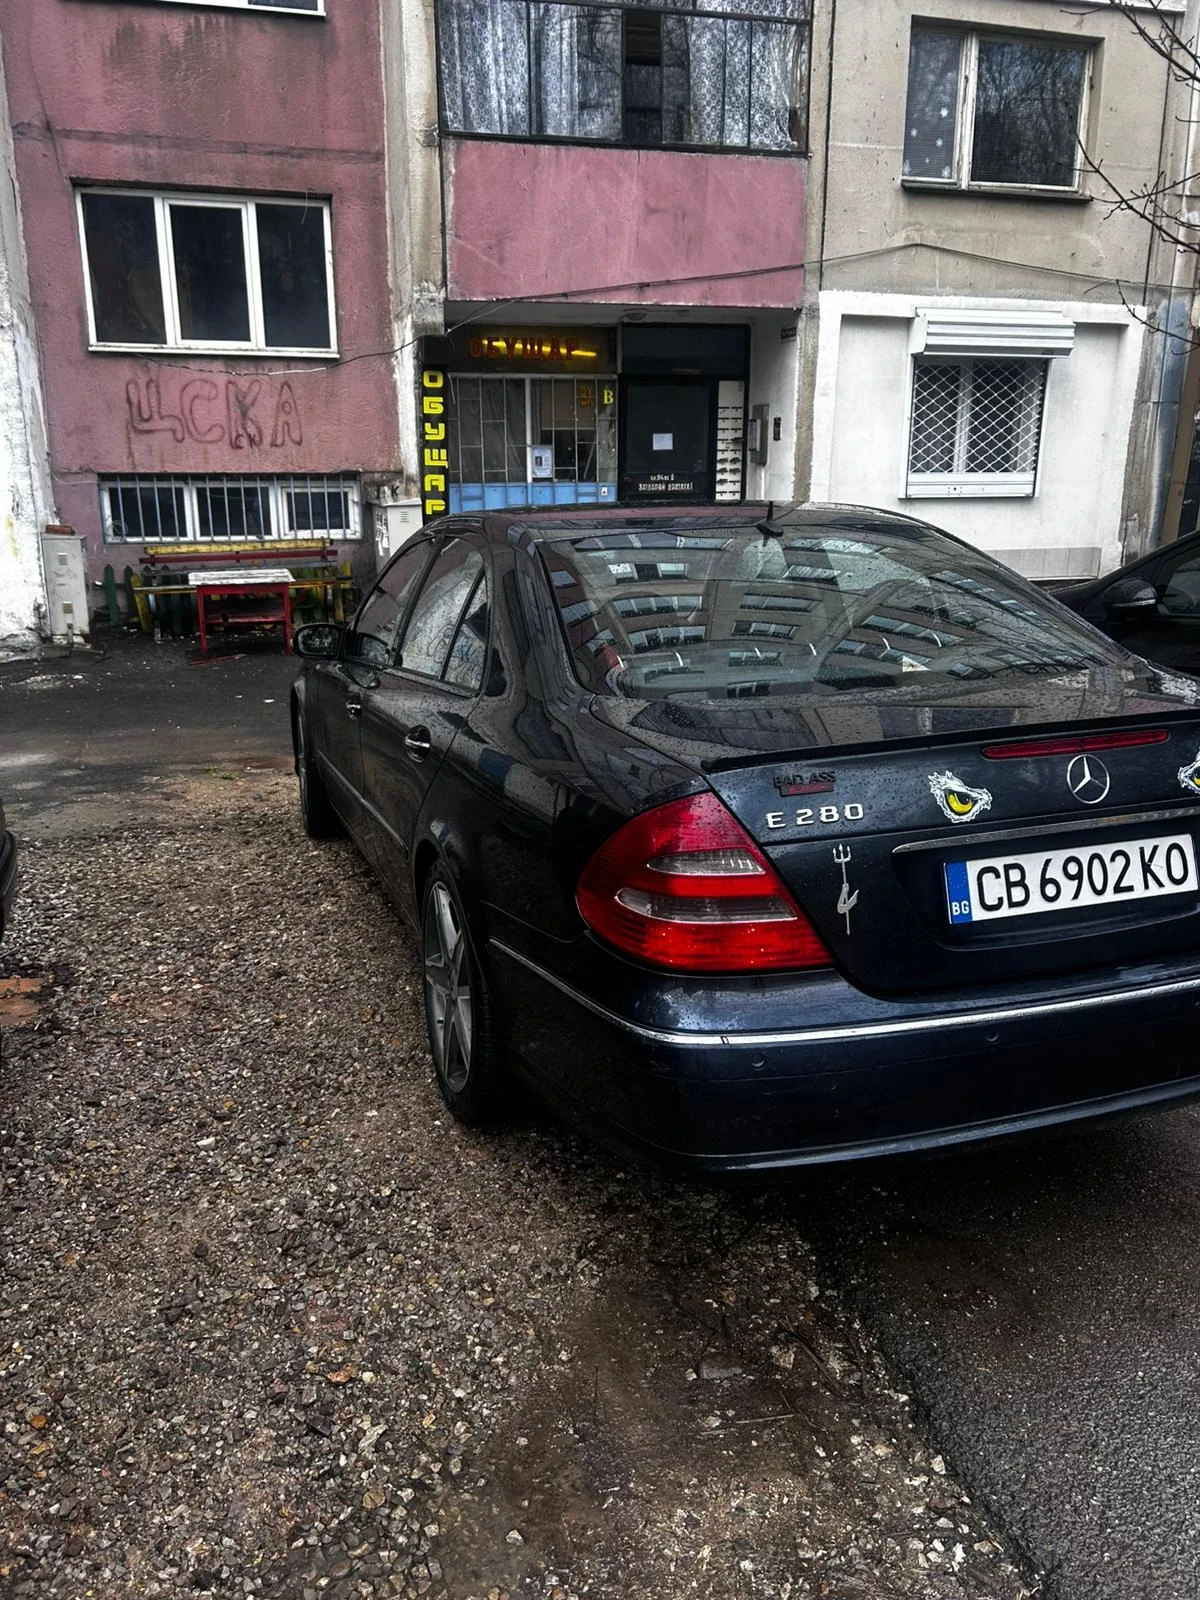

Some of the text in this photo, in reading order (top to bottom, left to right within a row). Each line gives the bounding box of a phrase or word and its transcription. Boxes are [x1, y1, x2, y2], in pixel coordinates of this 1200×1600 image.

[423, 370, 448, 515] ОБУЩАР
[766, 803, 864, 829] E 280
[952, 901, 970, 916] BG
